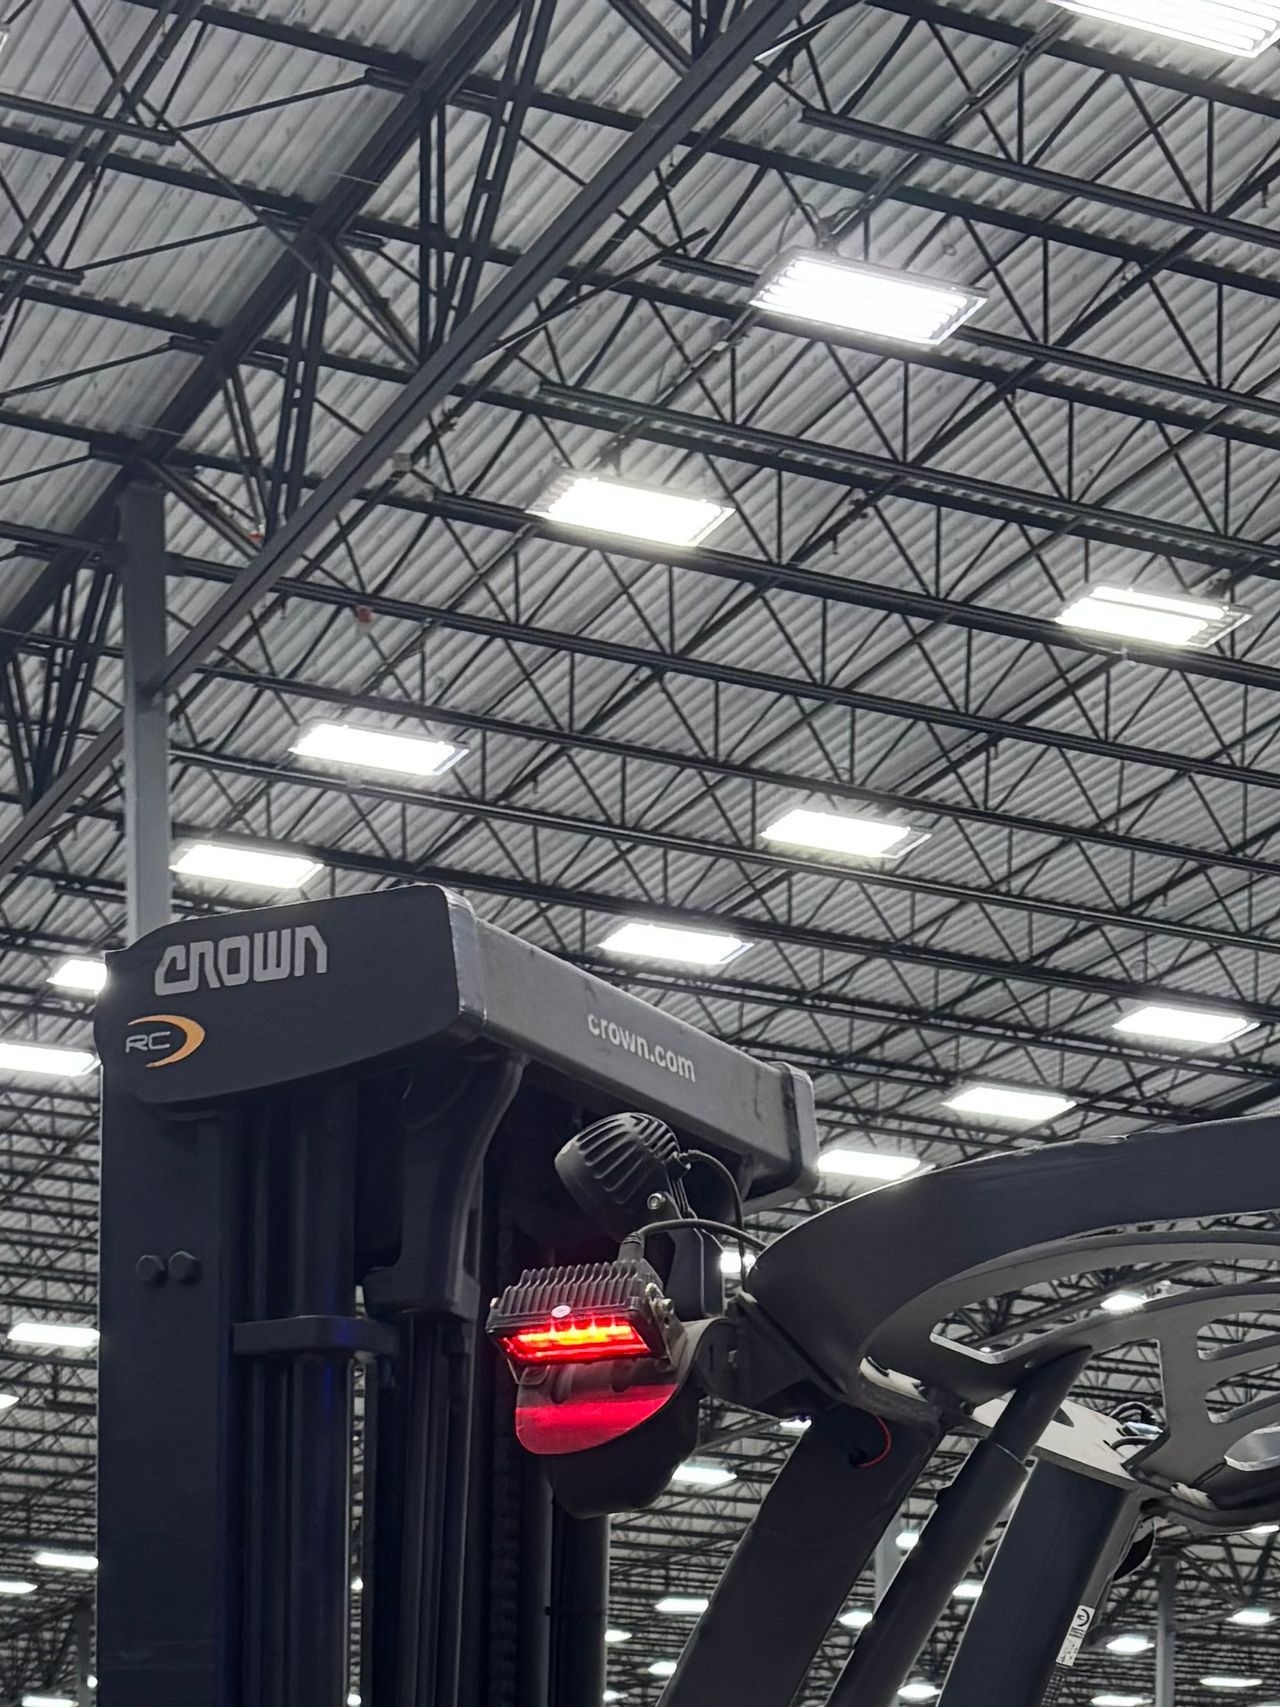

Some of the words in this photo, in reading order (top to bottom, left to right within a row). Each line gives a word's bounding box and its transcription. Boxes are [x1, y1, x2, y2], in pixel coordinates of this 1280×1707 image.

[154, 924, 328, 996] CROWN
[125, 1030, 171, 1054] RC
[586, 1012, 697, 1083] crown.com
